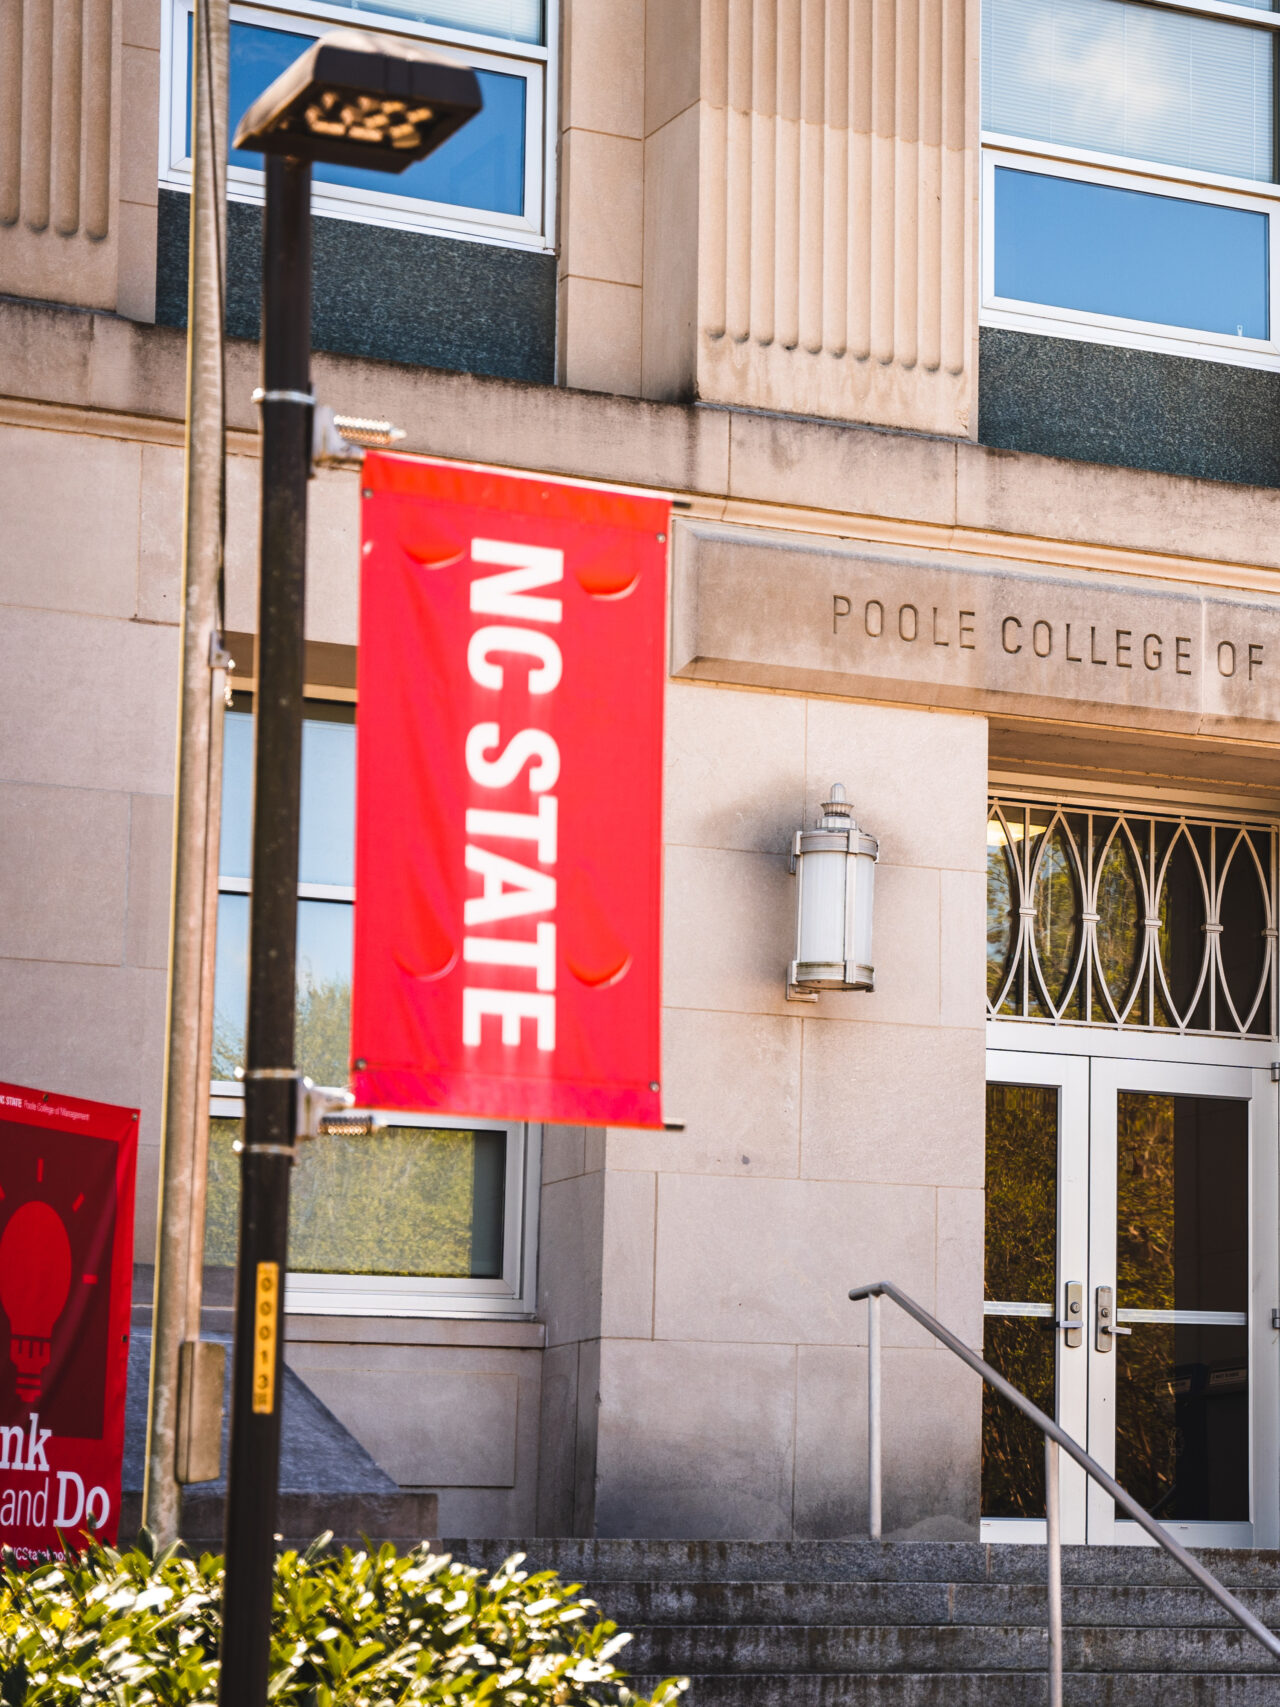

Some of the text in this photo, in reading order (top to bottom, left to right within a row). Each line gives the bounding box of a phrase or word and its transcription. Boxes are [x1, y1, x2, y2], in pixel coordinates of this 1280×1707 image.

[832, 594, 976, 651] POOLE
[1001, 615, 1193, 676] COLLEGE
[1216, 640, 1264, 681] OF
[462, 537, 564, 1051] NC STATE
[0, 1470, 110, 1529] and Do
